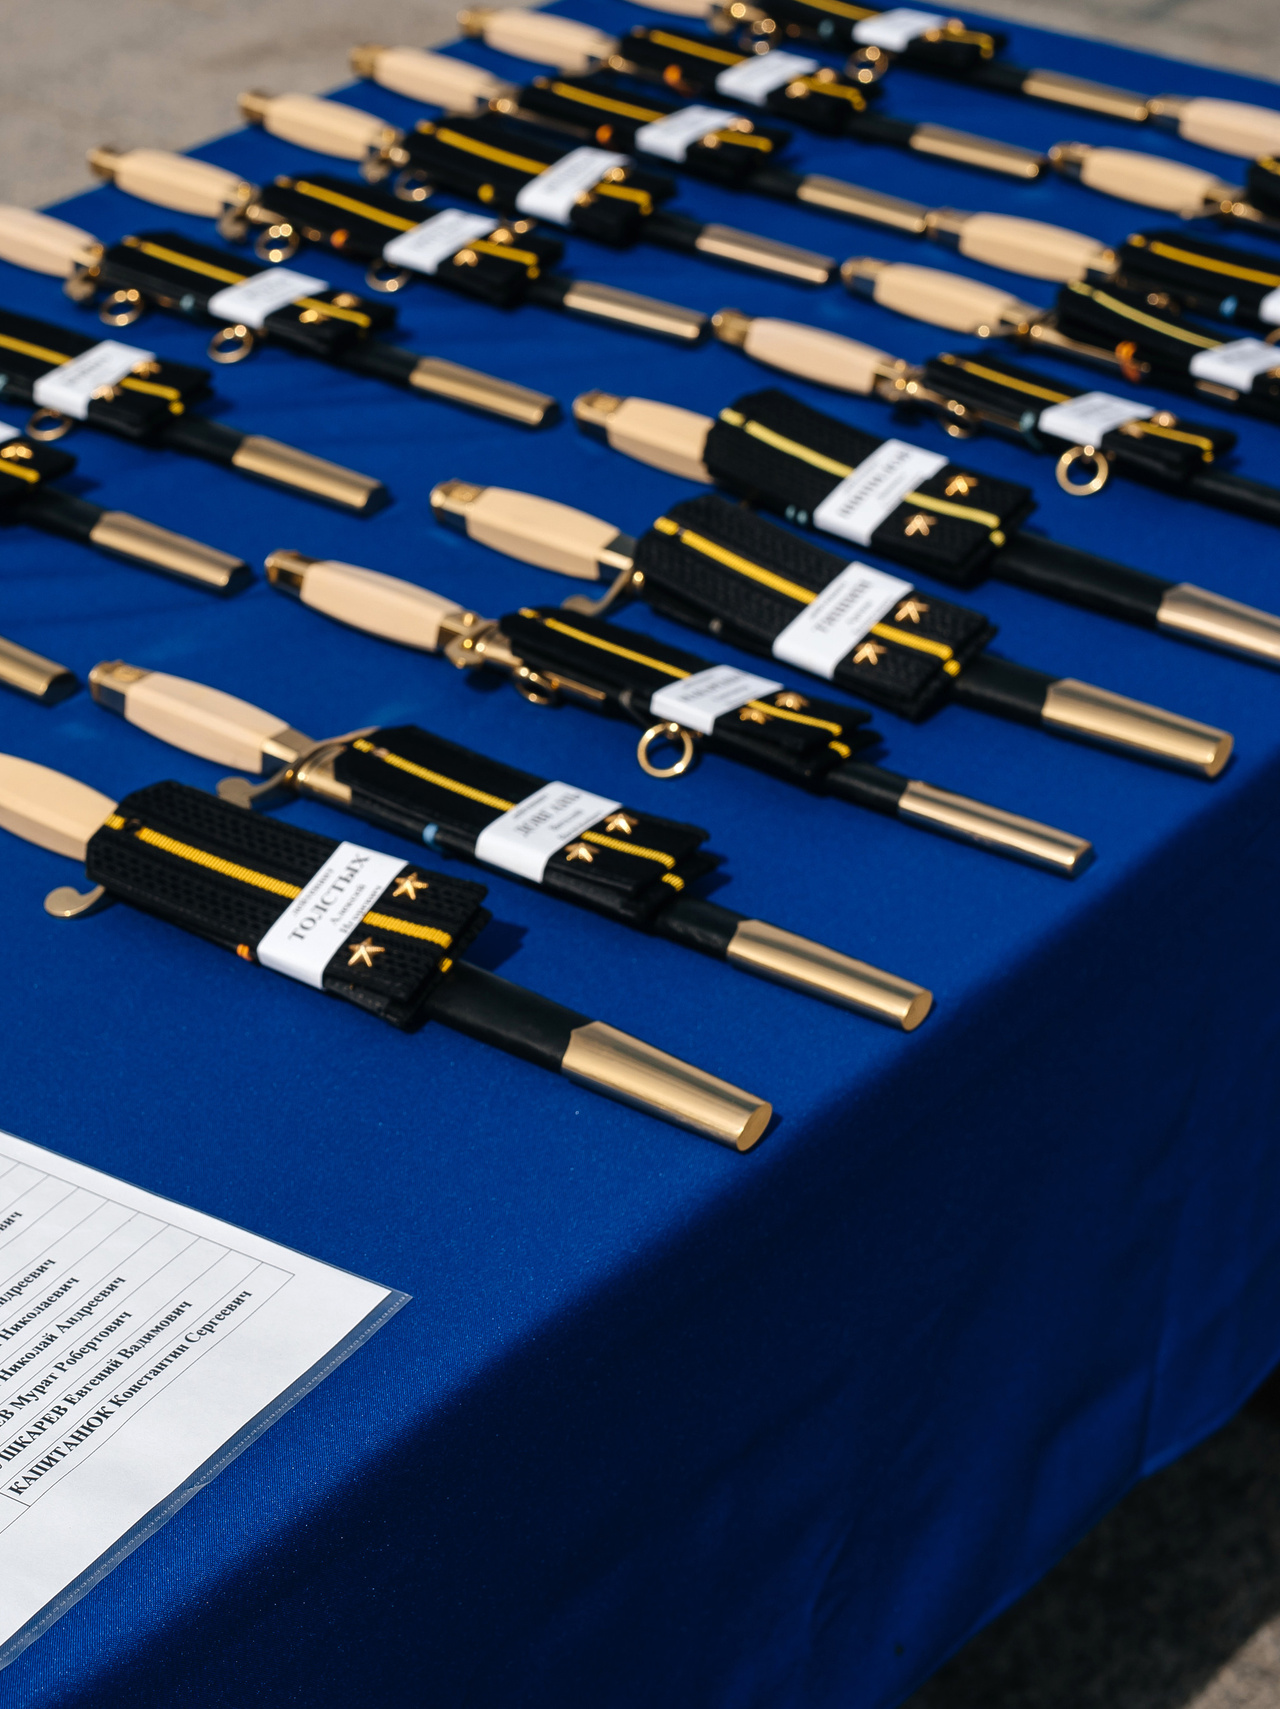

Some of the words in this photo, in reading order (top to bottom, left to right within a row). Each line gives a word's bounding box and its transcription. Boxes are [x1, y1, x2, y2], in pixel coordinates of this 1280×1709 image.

[288, 853, 371, 941] ТОЛСТЫХ
[54, 1275, 127, 1335] Андреевич
[59, 1357, 125, 1407] Евгений
[114, 1299, 194, 1361] Вадимович
[5, 1404, 117, 1497] КАПИТАНЮК
[105, 1342, 191, 1409] Константин
[183, 1289, 254, 1344] Сергеевич
[7, 1371, 60, 1411] Мурат
[50, 1310, 134, 1374] Робертович
